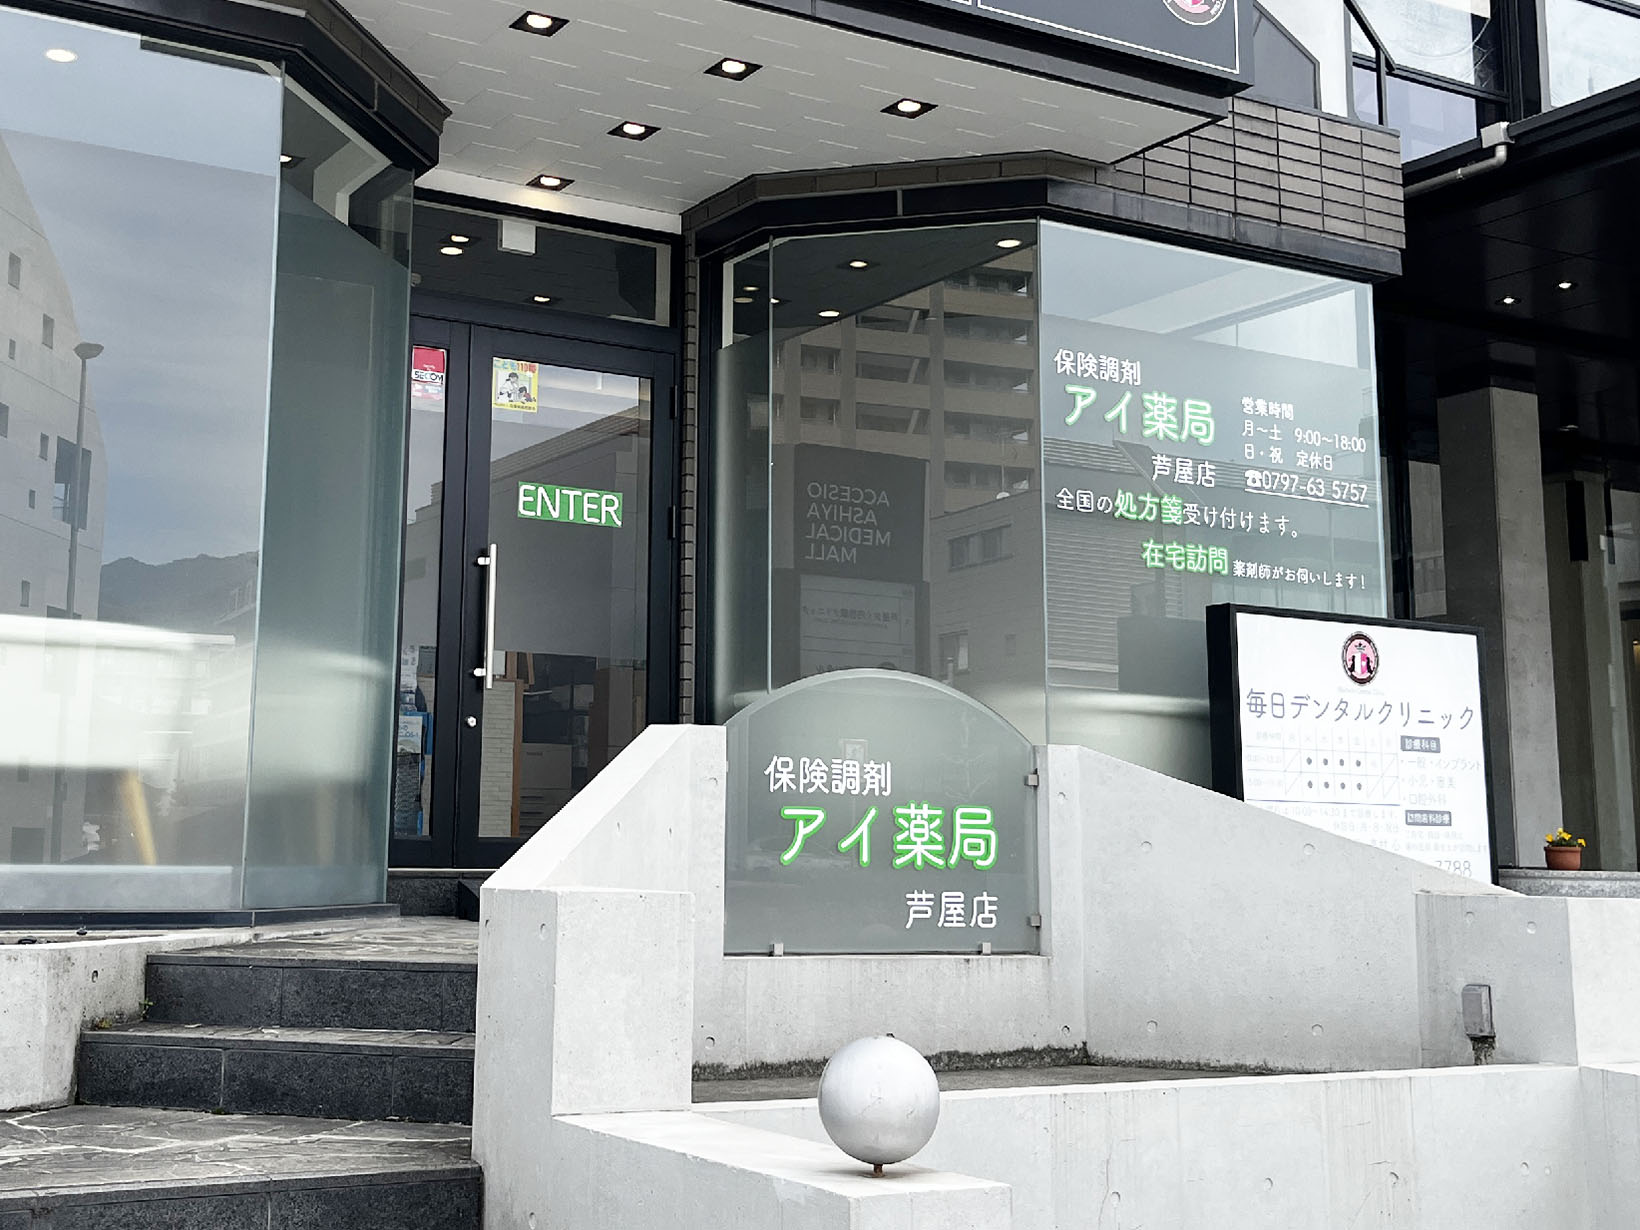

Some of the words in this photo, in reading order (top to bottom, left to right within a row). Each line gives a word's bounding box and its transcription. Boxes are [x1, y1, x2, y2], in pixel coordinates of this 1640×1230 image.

[414, 371, 443, 383] SECOM
[1054, 348, 1141, 386] 保険調剤
[1063, 383, 1216, 446] アイ薬局
[1241, 396, 1294, 420] 営業時間
[1151, 454, 1216, 488] 芦屋店
[1244, 443, 1283, 464] 日・祝
[1296, 450, 1333, 471] 定休日
[518, 484, 622, 527] ENTER
[1332, 480, 1368, 502] 5757
[1056, 487, 1298, 539] 全国の処方箋受け付けます。
[1141, 538, 1229, 576] 在宅訪問
[1246, 688, 1475, 730] 毎日デンタルクリニック
[763, 754, 892, 797] 保険調剤
[780, 799, 999, 871] アイ薬局
[904, 889, 999, 929] 芦屋店
